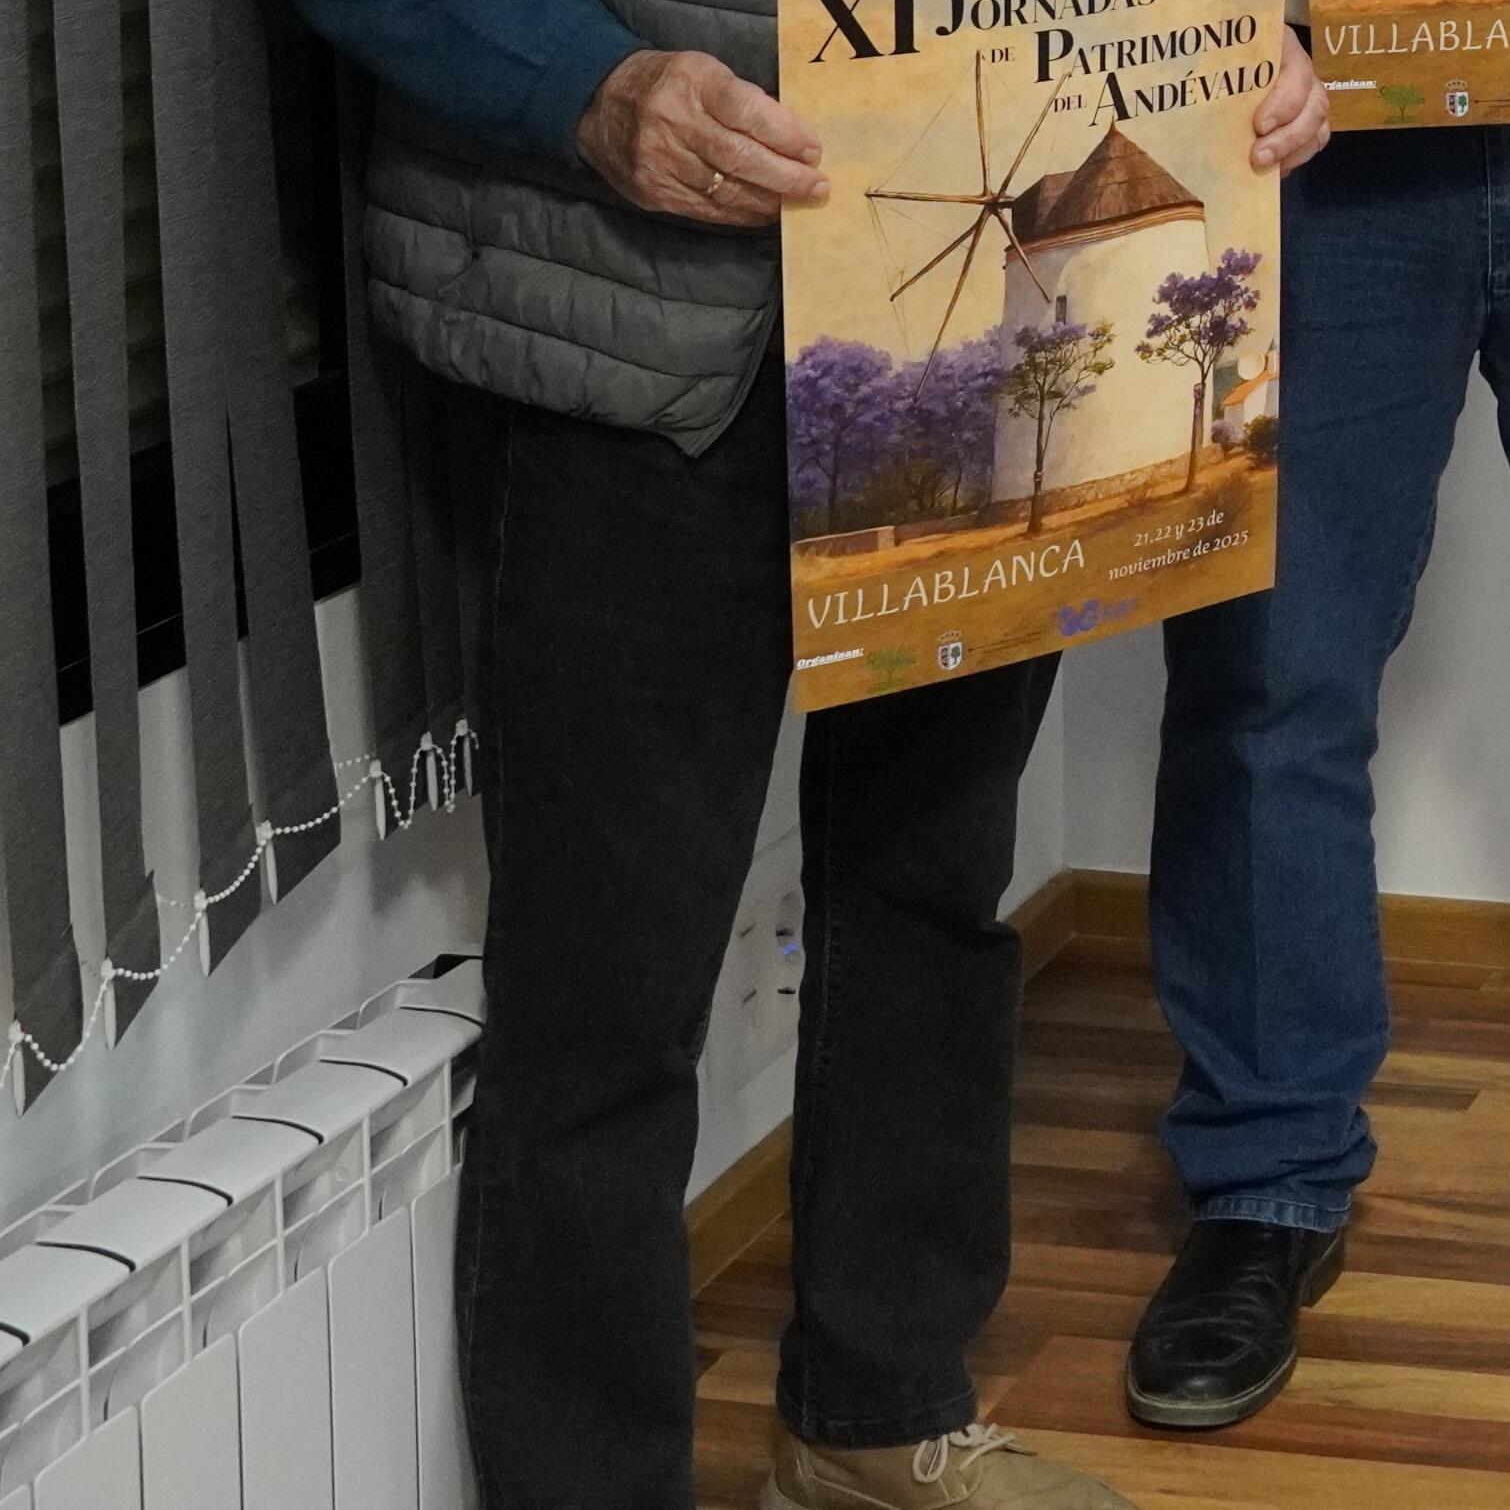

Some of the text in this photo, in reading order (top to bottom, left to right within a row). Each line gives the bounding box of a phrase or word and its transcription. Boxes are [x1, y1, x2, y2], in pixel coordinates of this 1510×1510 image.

[991, 45, 1016, 63] DE
[1053, 95, 1088, 114] DEL
[1176, 523, 1185, 540] y
[1188, 516, 1204, 532] 23
[1207, 509, 1224, 526] de
[1108, 530, 1249, 580] noviembre de 2025
[808, 538, 1086, 629] VILLABLANCA
